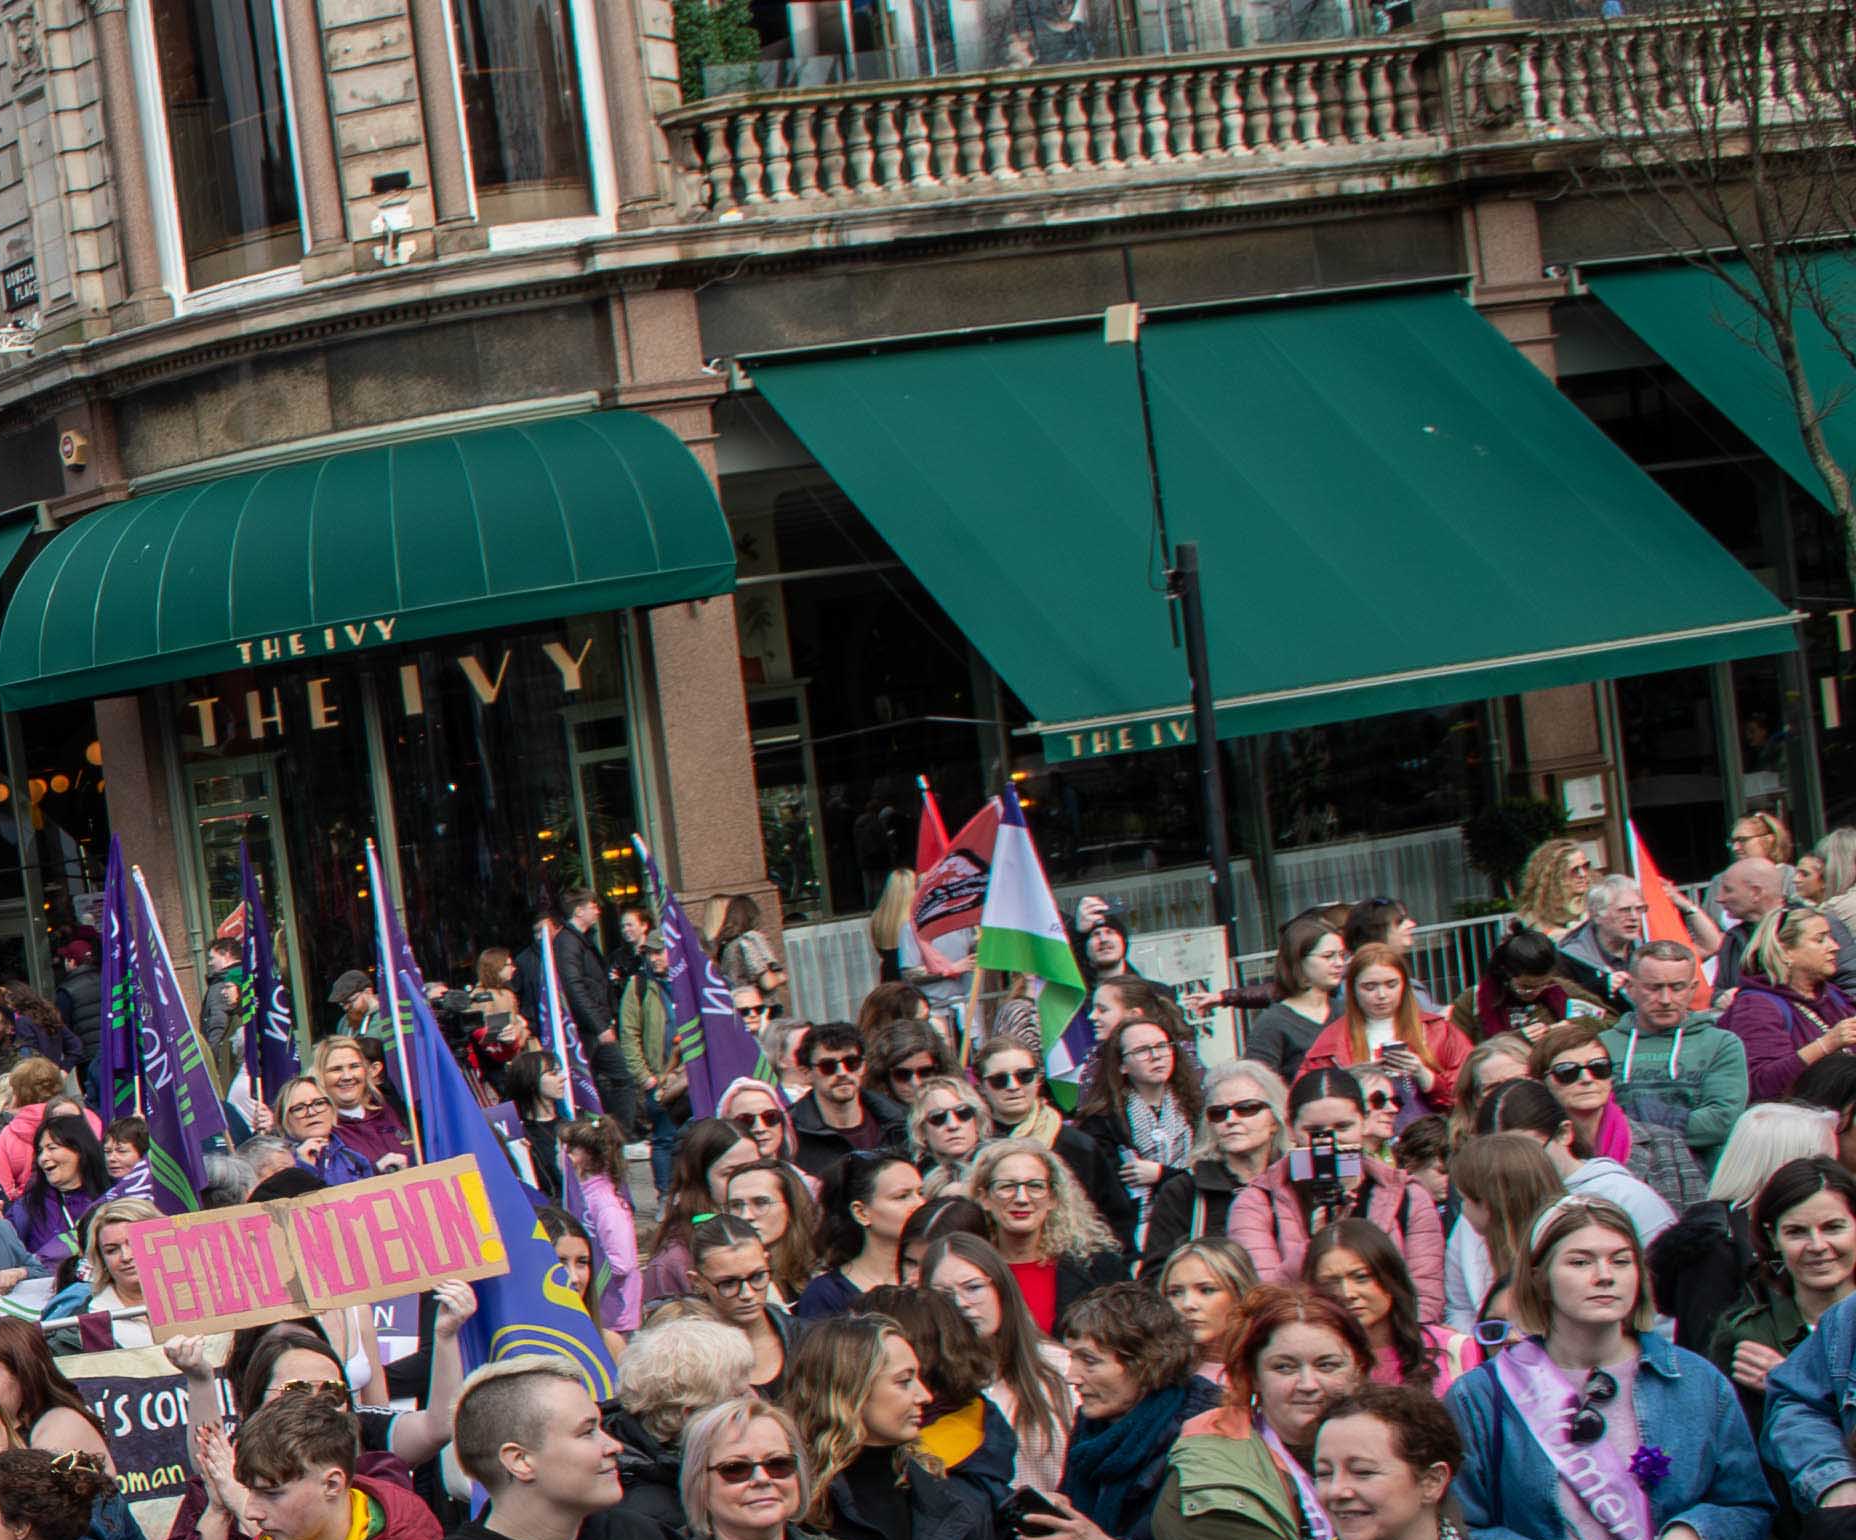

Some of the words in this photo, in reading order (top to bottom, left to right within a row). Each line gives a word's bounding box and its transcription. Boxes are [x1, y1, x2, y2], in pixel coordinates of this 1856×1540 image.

[236, 633, 306, 664] THE
[324, 617, 397, 650] IVY
[189, 677, 341, 747] THE
[398, 638, 593, 717] IVY
[1066, 727, 1133, 757] THE
[1151, 719, 1188, 746] IV
[114, 1462, 185, 1495] oman
